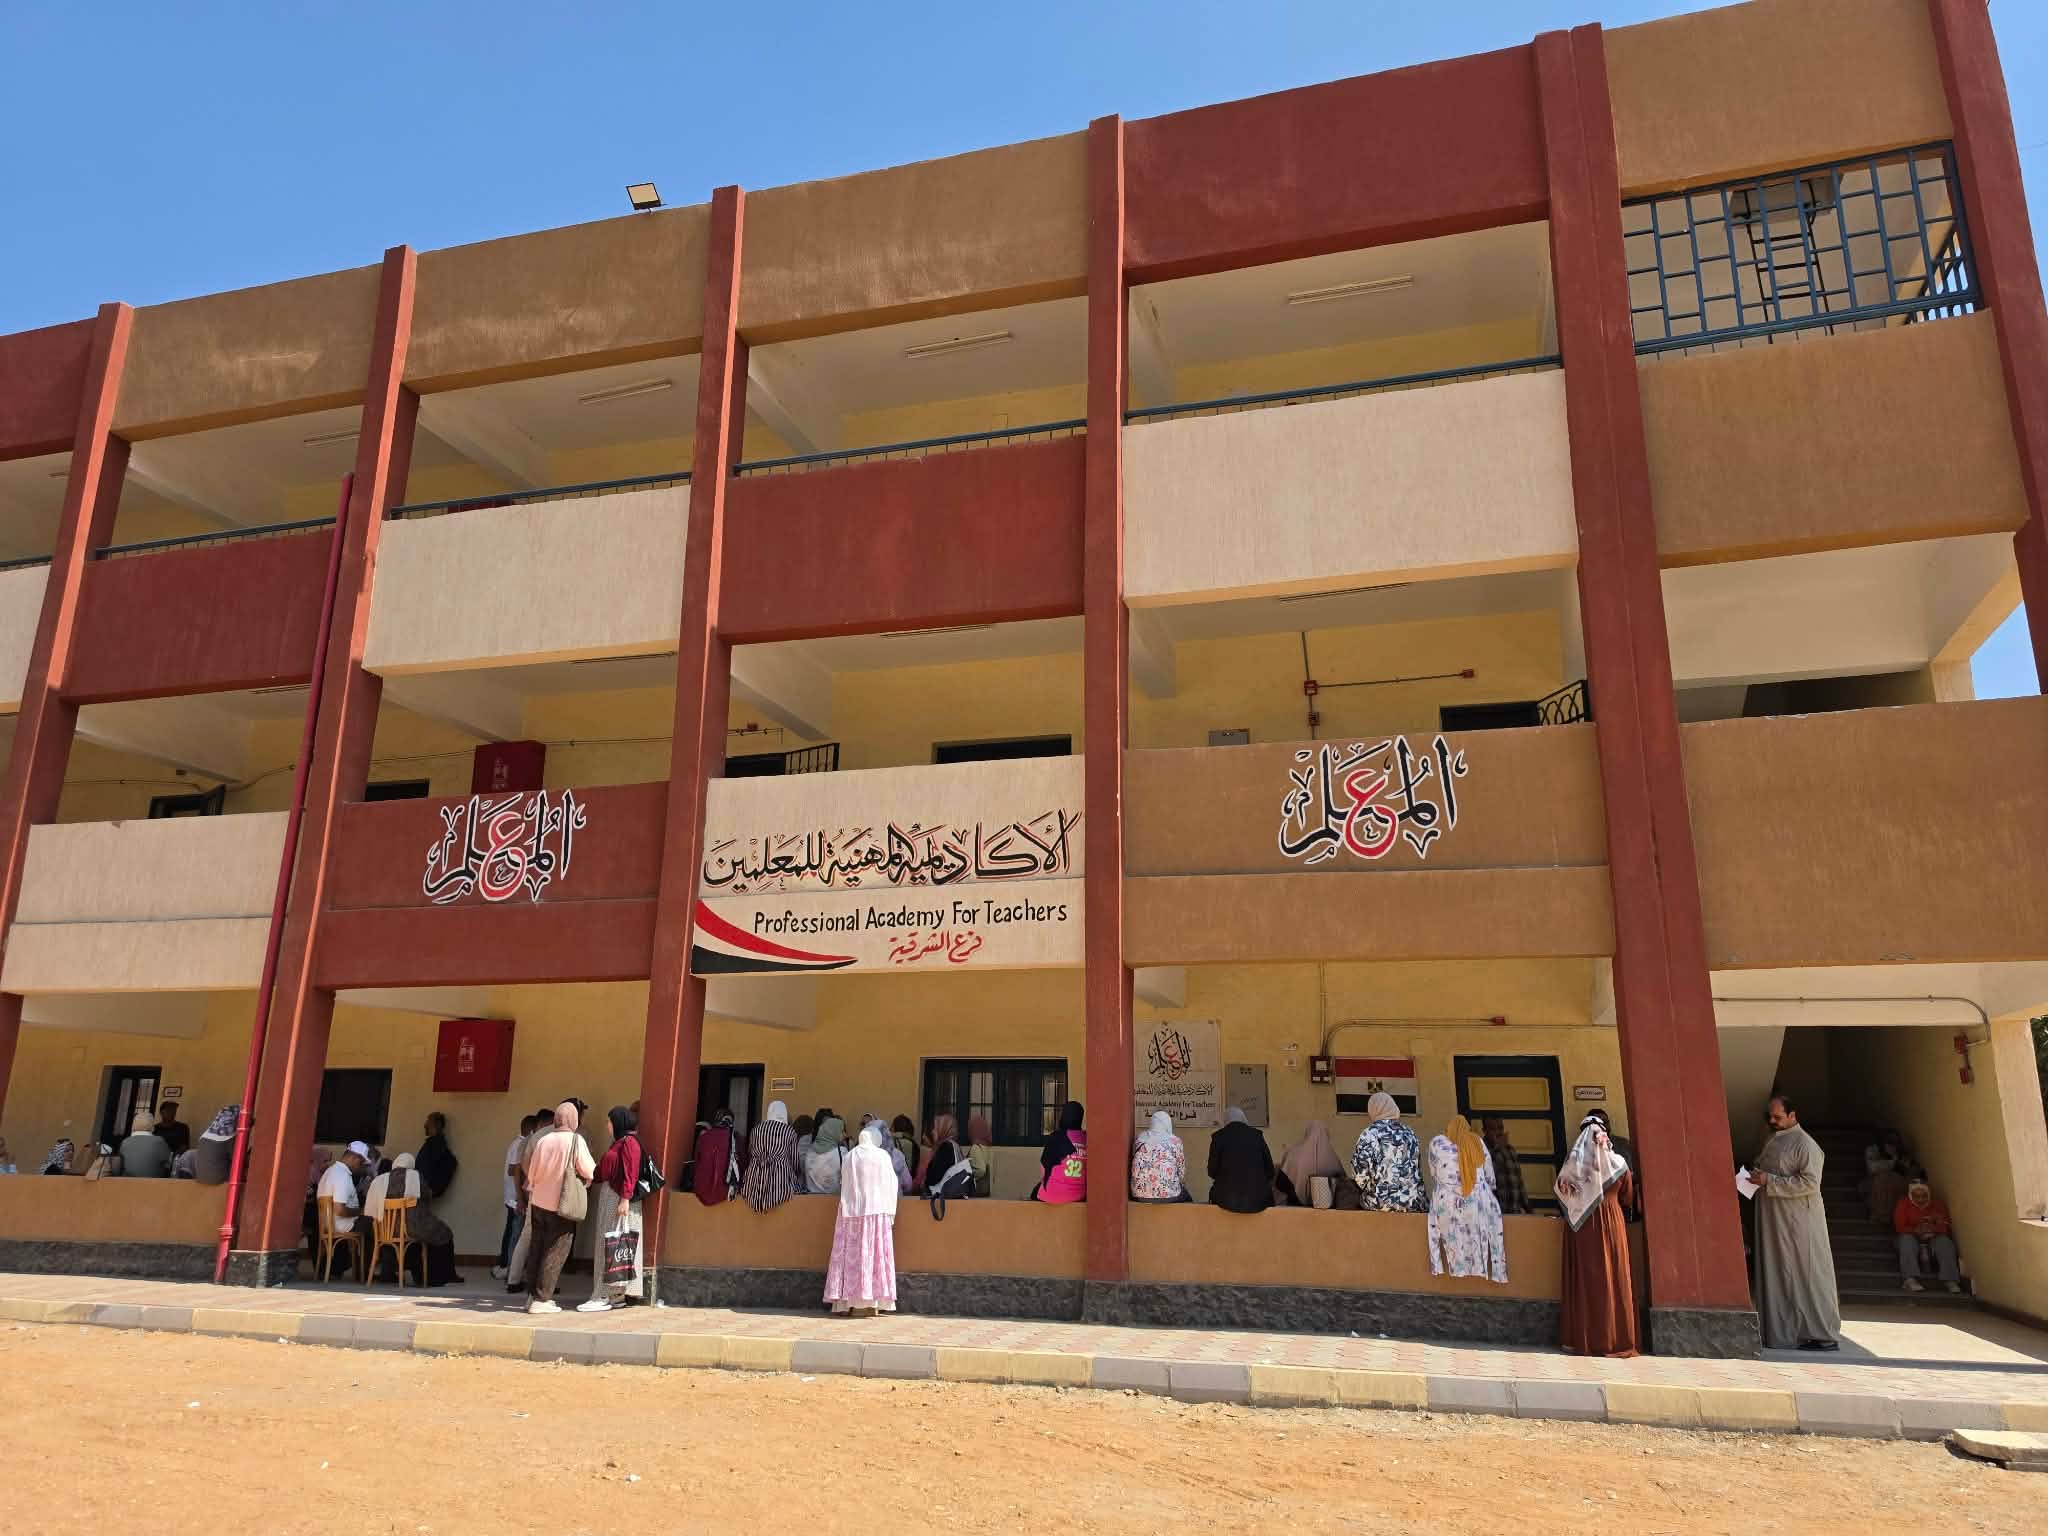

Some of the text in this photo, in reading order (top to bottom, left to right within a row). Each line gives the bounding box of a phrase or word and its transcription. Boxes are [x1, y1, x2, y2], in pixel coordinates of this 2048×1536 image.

[754, 898, 1068, 934] Professional Academy For Teachers
[888, 929, 985, 964] فرع الشرقية
[1064, 1159, 1082, 1178] 32
